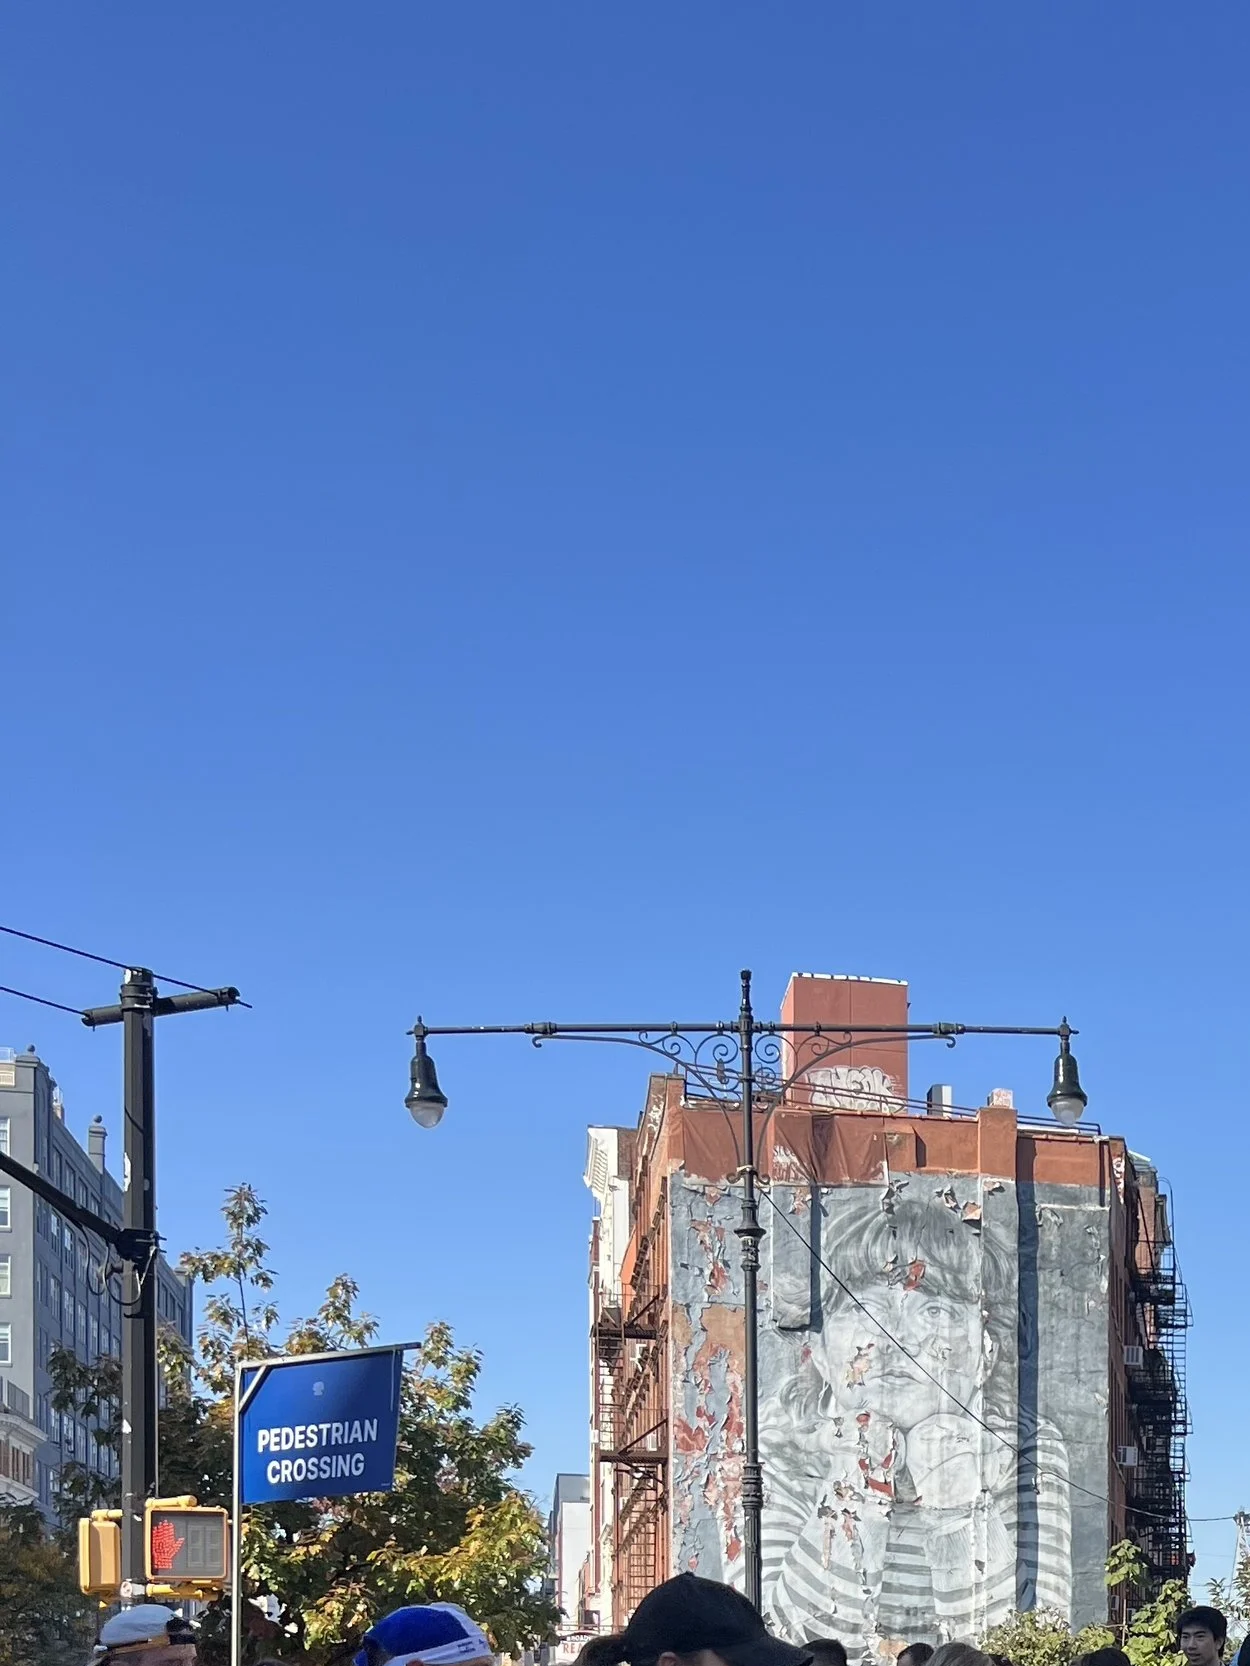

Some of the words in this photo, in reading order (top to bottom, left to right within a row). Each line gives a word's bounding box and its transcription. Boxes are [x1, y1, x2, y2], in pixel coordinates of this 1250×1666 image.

[258, 1418, 378, 1453] PEDESTRIAN
[267, 1452, 365, 1484] CROSSING
[566, 1634, 591, 1642] BROAD
